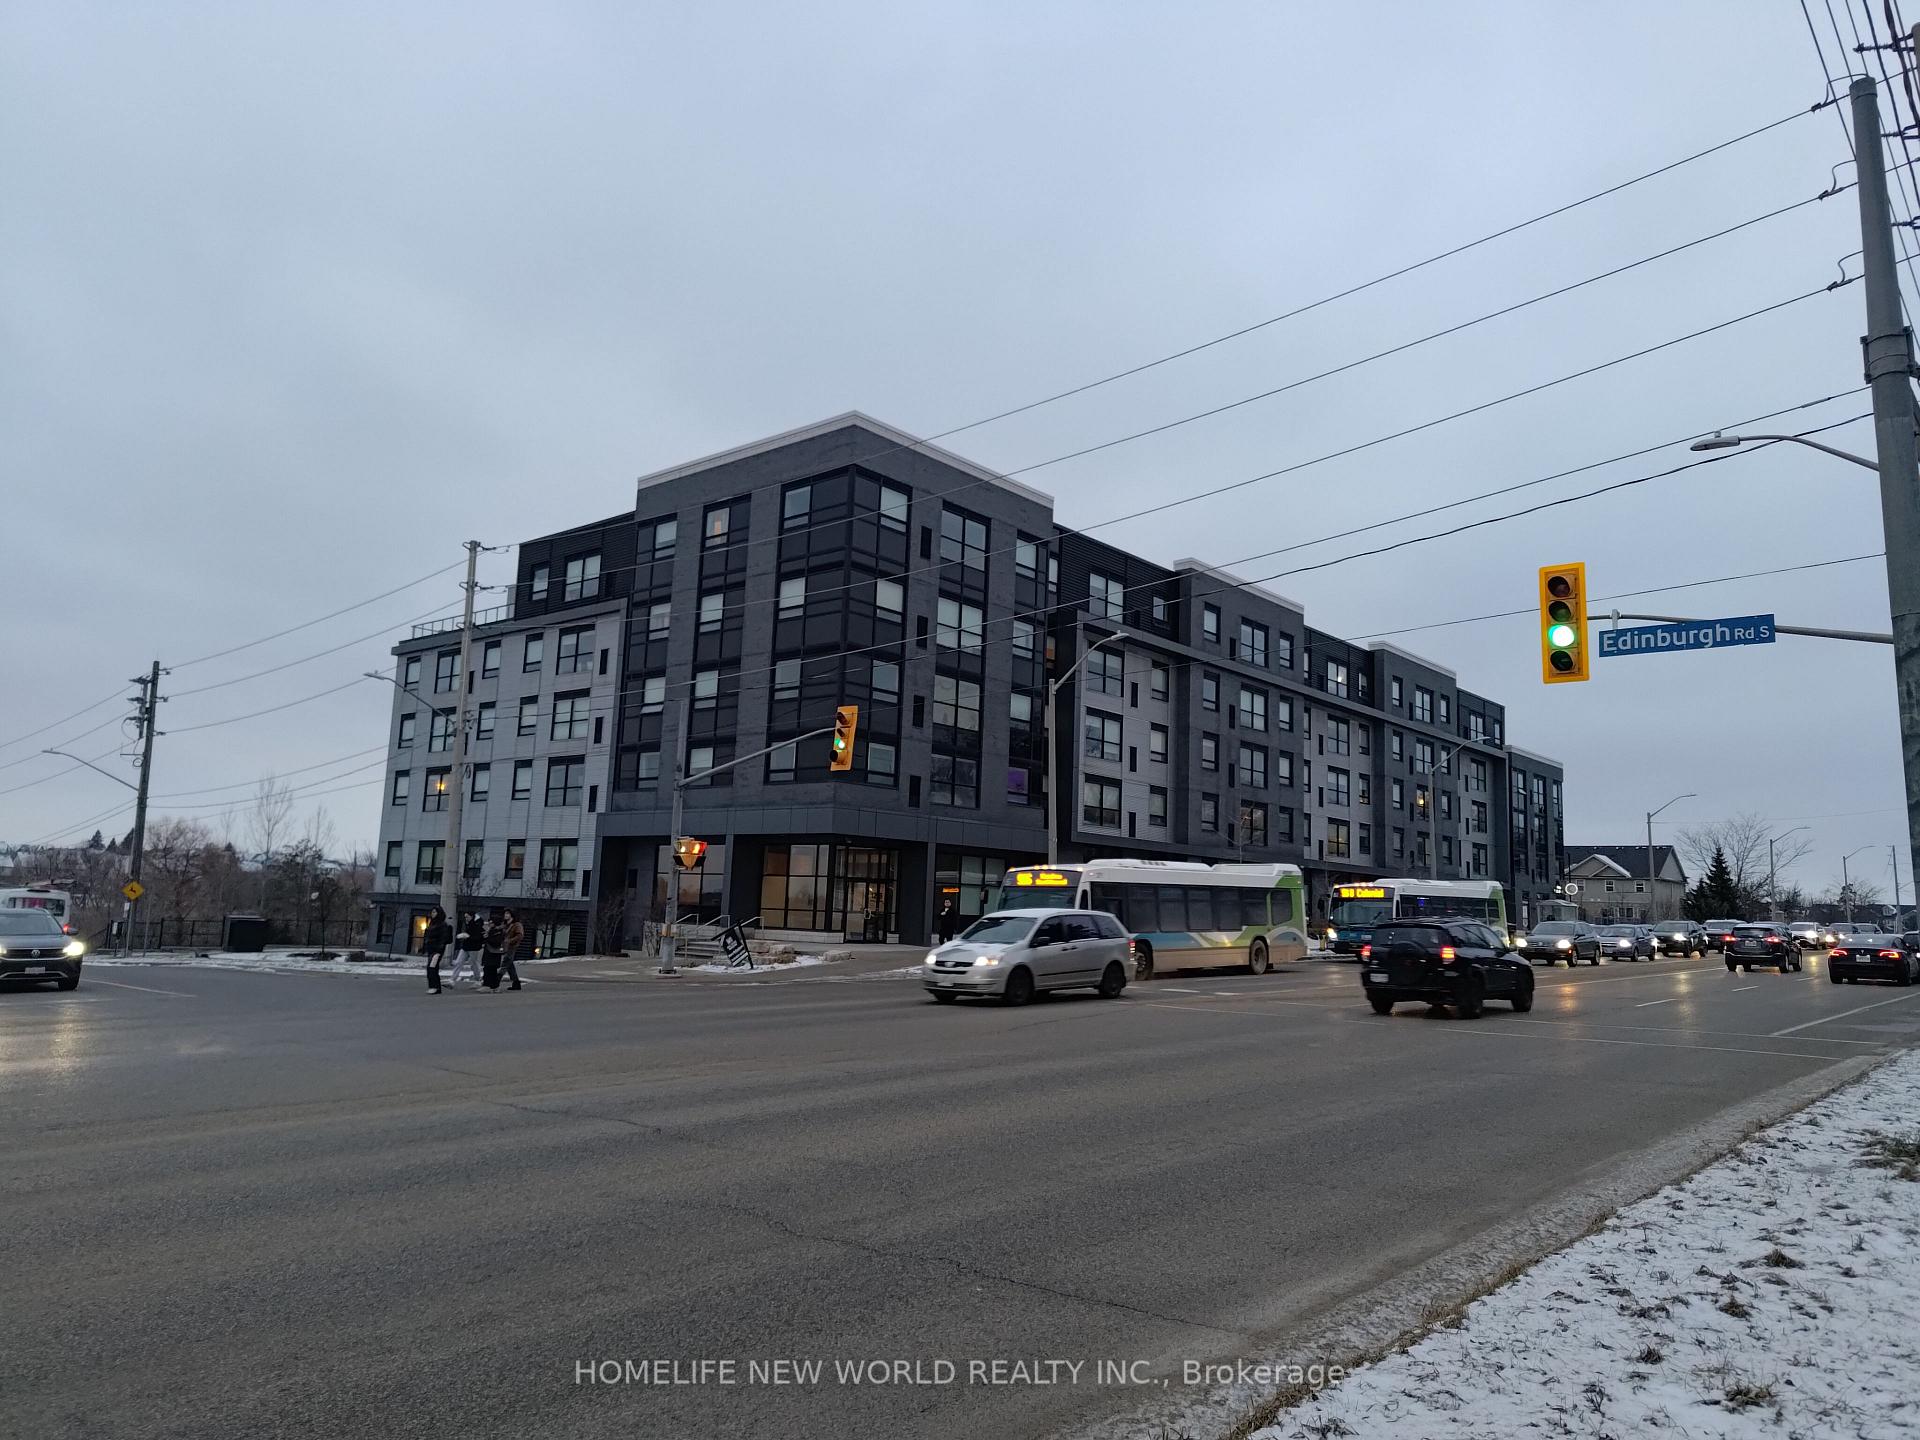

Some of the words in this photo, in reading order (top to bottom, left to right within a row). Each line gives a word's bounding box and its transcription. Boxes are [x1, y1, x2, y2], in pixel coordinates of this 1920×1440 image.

[1603, 624, 1730, 652] Edinburgh
[1734, 627, 1754, 640] Rd
[1760, 626, 1770, 639] S
